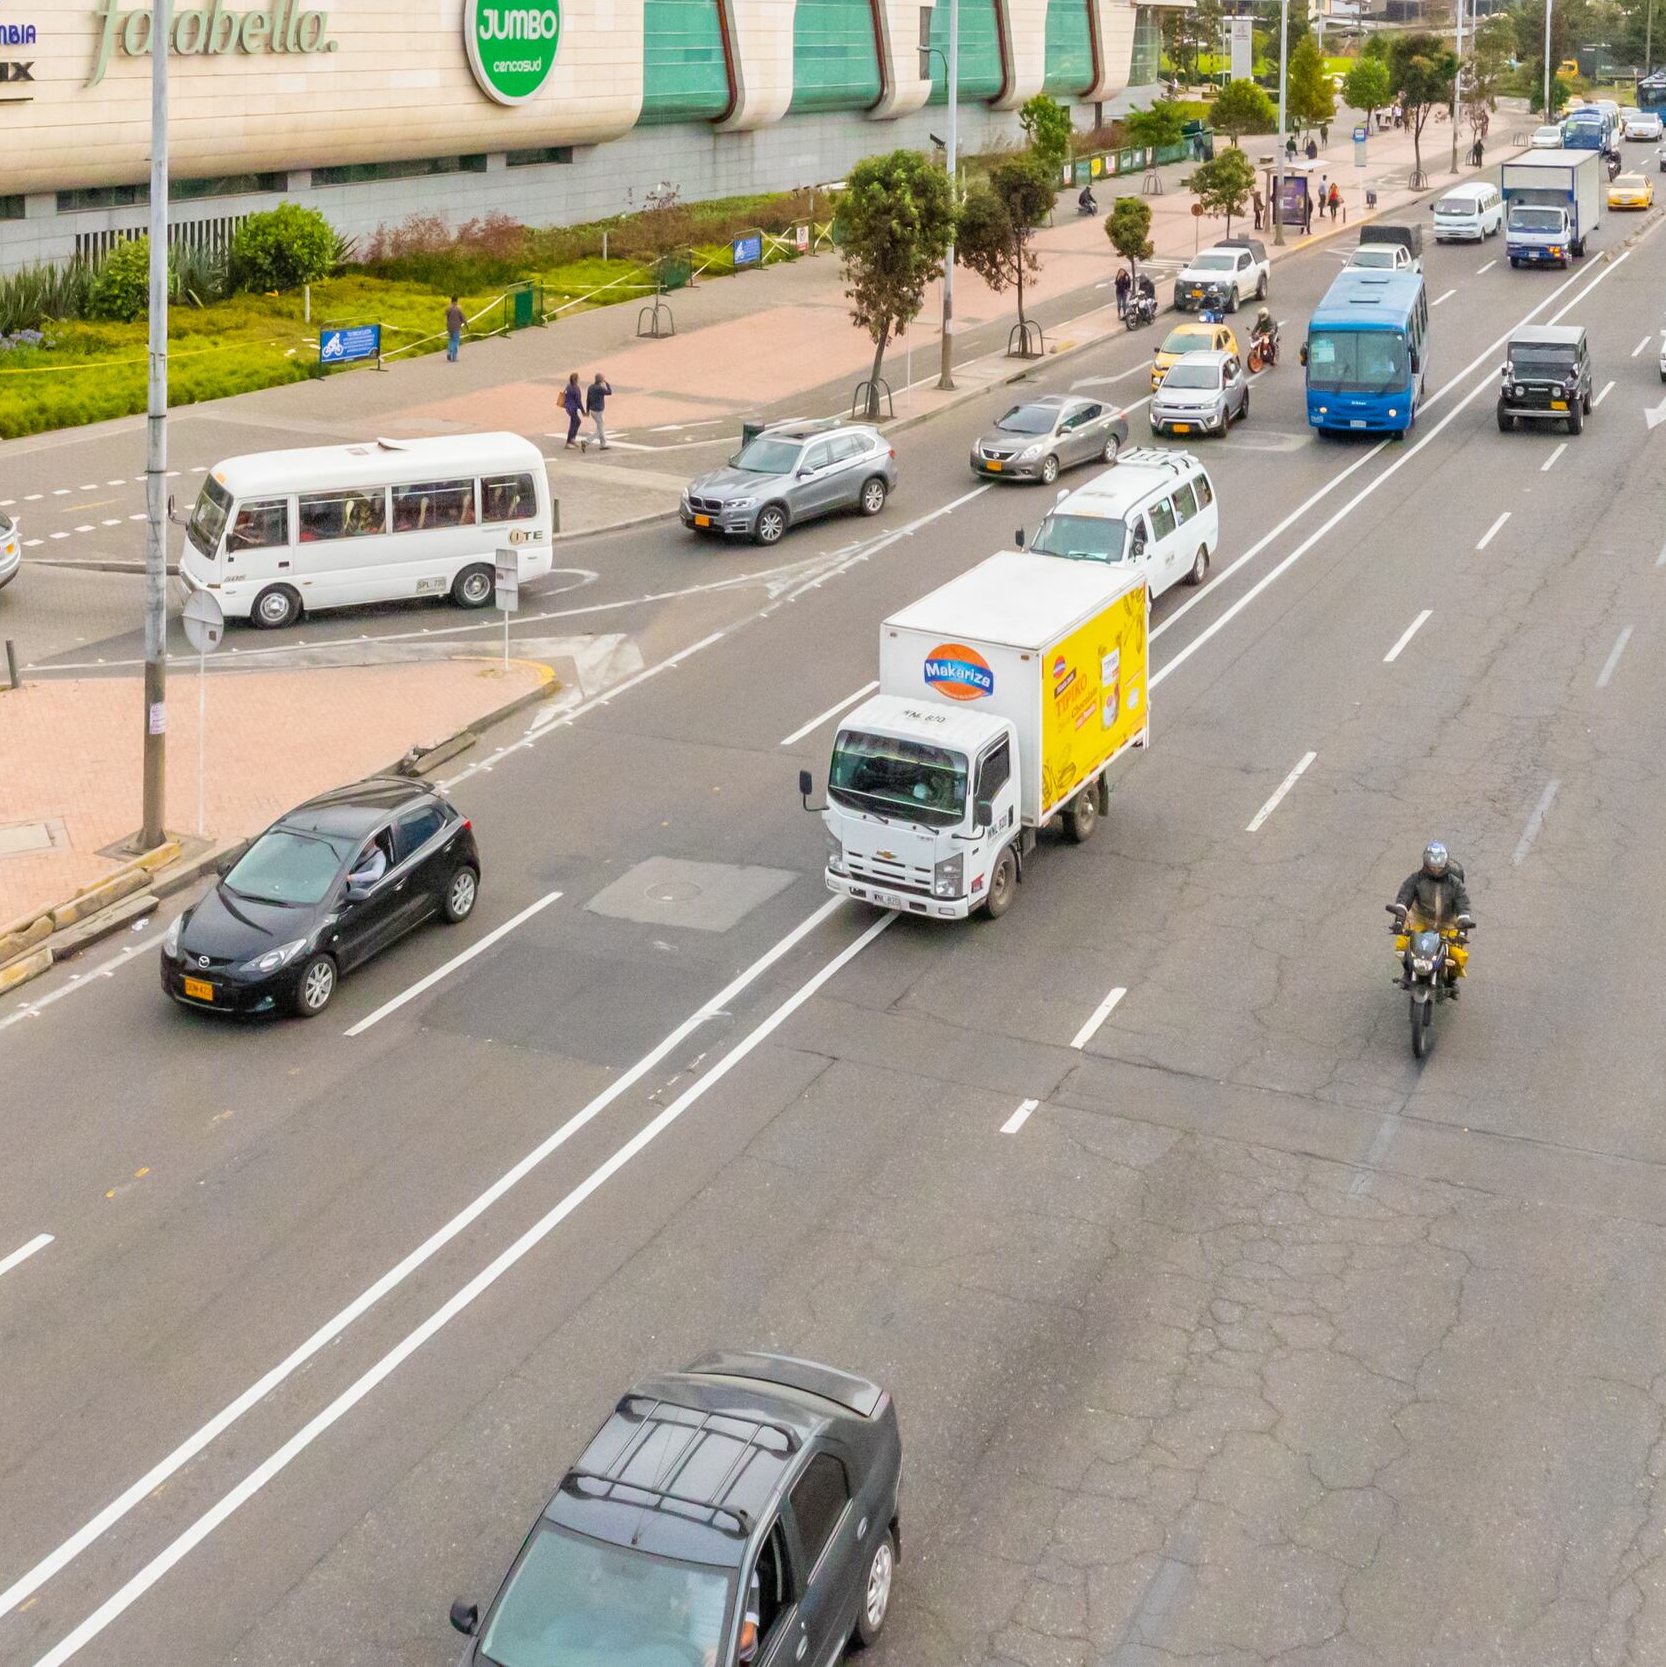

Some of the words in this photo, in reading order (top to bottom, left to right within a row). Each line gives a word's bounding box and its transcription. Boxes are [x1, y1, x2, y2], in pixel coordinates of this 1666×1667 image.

[479, 8, 557, 40] JUMBO
[493, 57, 542, 73] cencosud
[925, 661, 991, 688] Makariza
